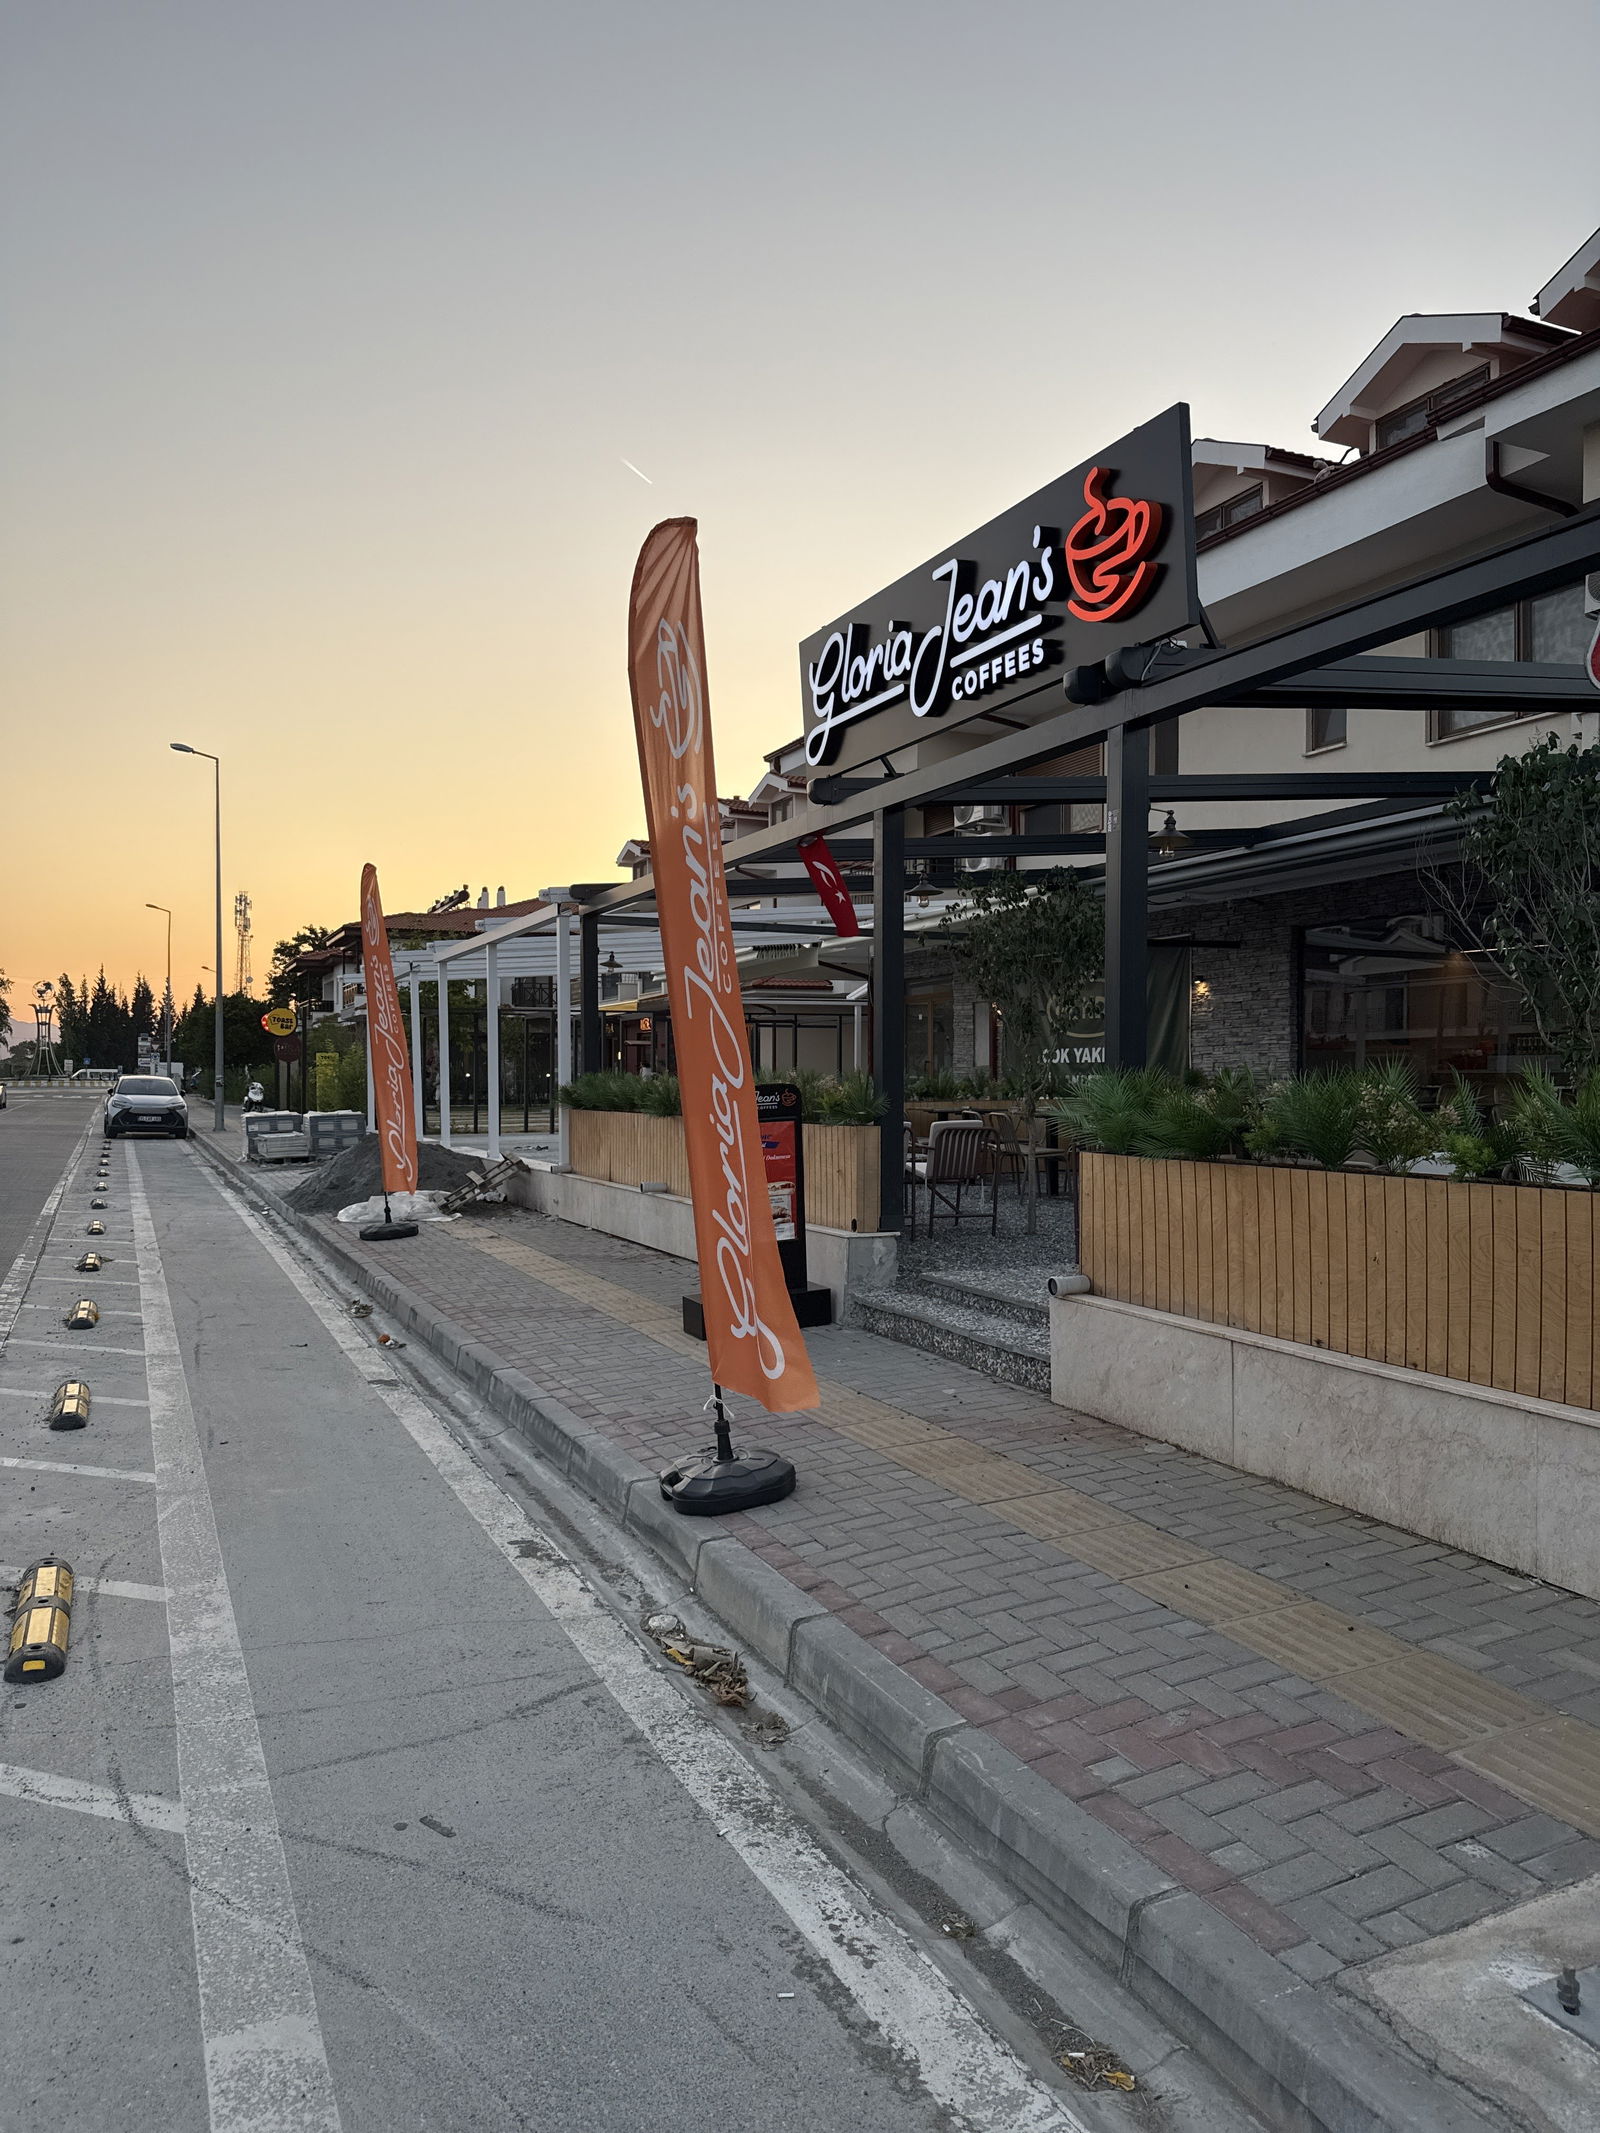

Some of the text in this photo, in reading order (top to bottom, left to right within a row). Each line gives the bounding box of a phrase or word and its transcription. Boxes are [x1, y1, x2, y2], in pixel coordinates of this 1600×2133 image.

[806, 525, 1055, 766] Gloria Jean's
[951, 638, 1045, 701] COFFEES
[382, 963, 399, 1034] COFFEES
[711, 804, 732, 994] COFFEES
[370, 953, 413, 1182] Gloria Jean's
[671, 782, 785, 1380] Gloria Jean's
